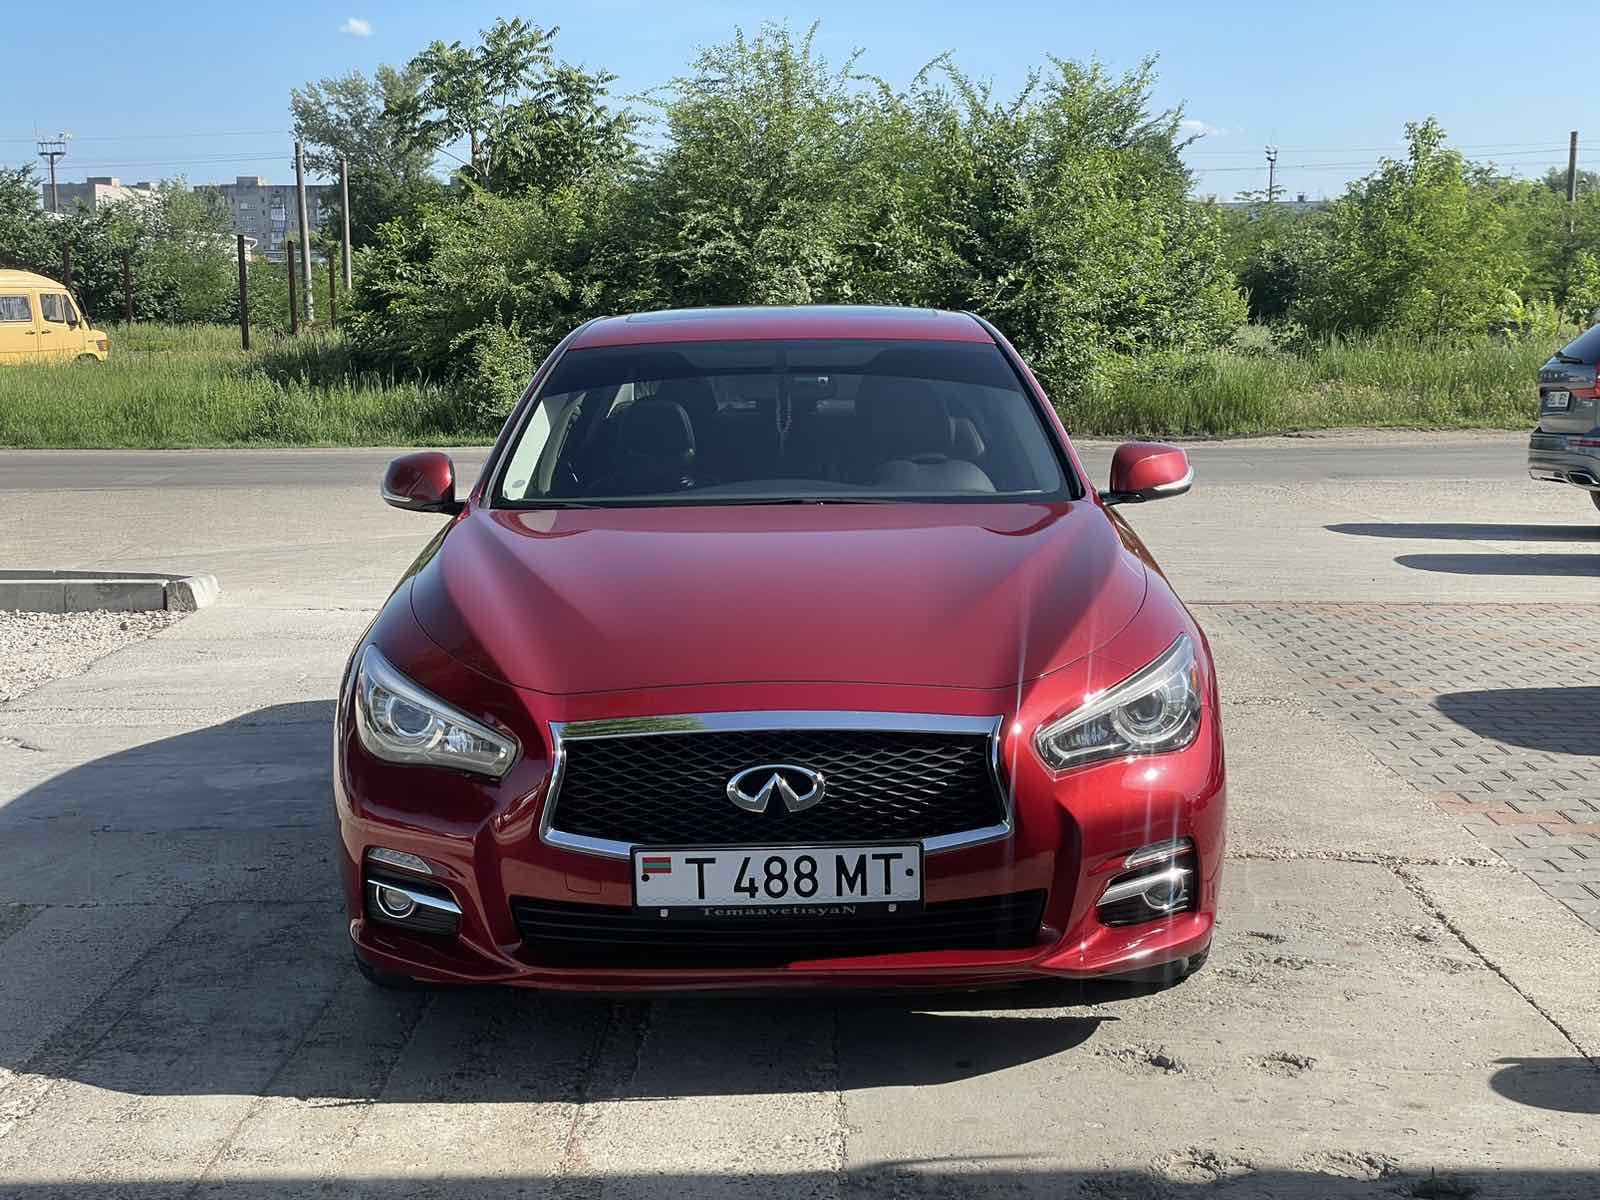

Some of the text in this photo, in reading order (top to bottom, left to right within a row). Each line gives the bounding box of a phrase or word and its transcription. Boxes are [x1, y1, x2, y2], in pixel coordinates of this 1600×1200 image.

[684, 852, 903, 899] T 488 MT
